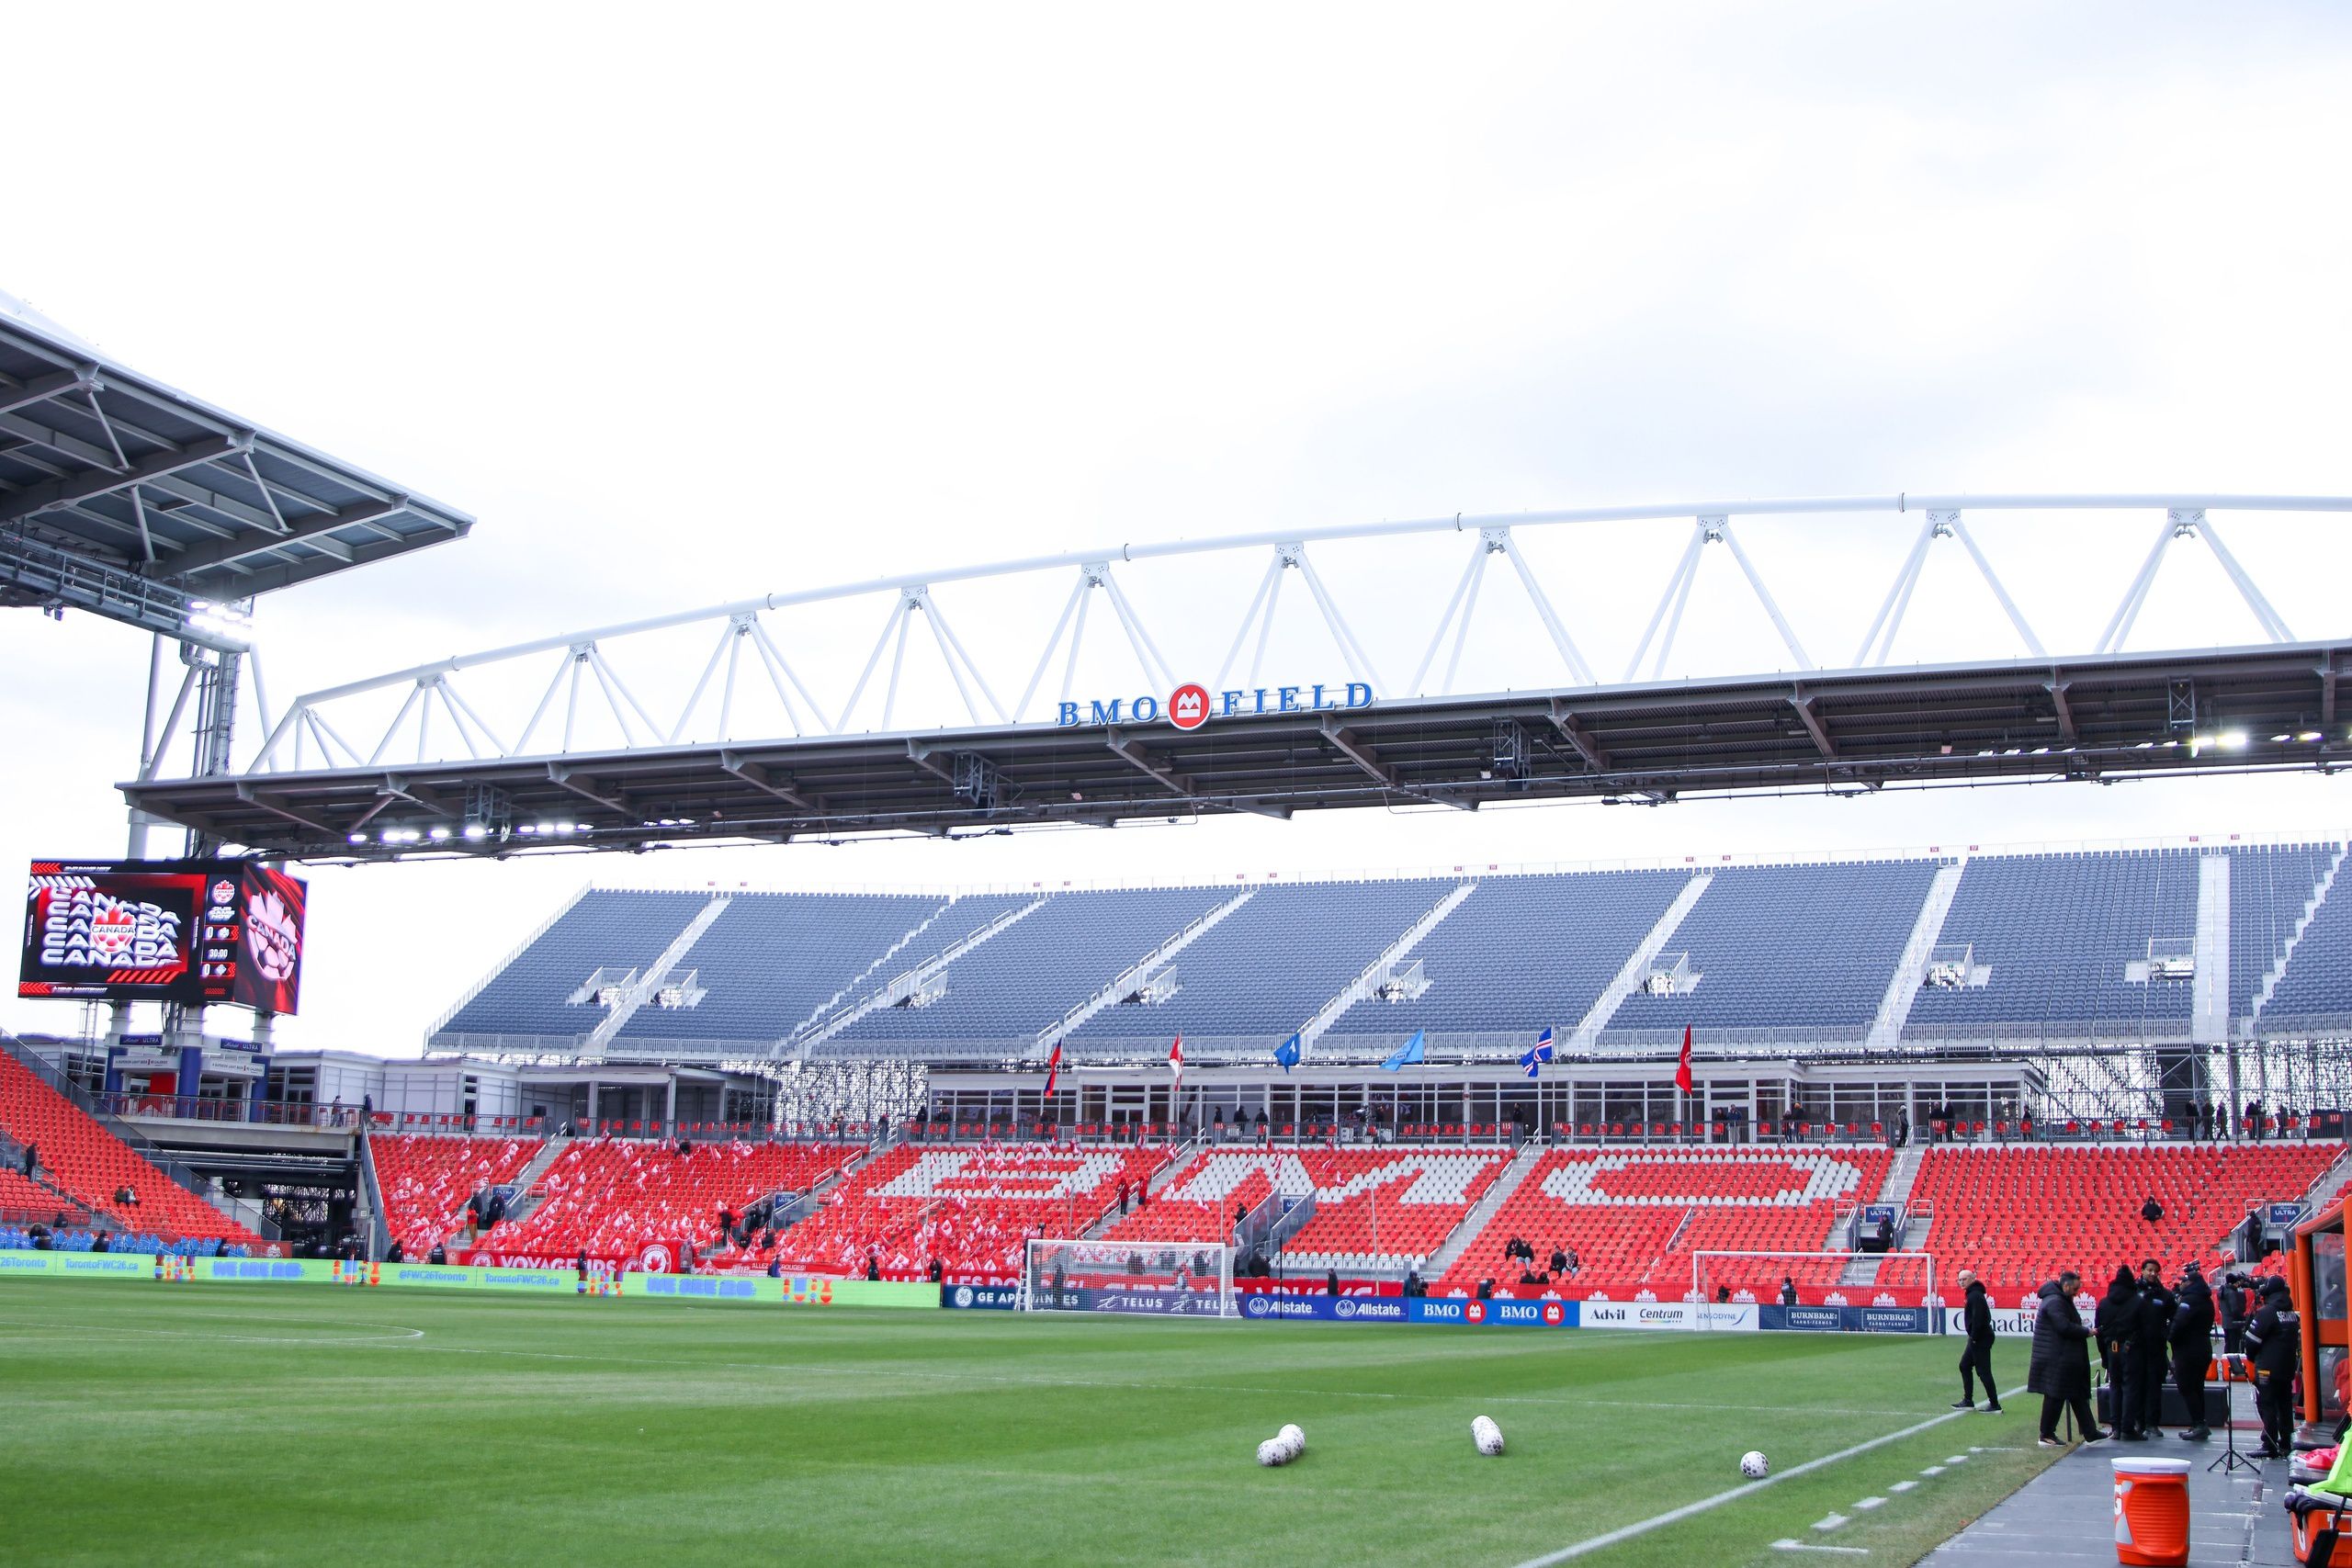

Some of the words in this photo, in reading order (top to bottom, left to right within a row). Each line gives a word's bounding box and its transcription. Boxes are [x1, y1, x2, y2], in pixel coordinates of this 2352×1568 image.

[1057, 694, 1159, 728] BMO
[1220, 682, 1374, 717] FIELD
[92, 925, 136, 934] CANADA
[0, 1256, 47, 1269] 26Toronto
[978, 1292, 995, 1303] GE
[1122, 1296, 1163, 1308] TELUS
[1355, 1303, 1401, 1316] Allstate
[1423, 1303, 1461, 1316] BMO
[1500, 1306, 1538, 1319] BMO
[1590, 1308, 1625, 1320] Advil
[1639, 1308, 1683, 1319] Centrum
[1953, 1308, 2036, 1333] Cnada
